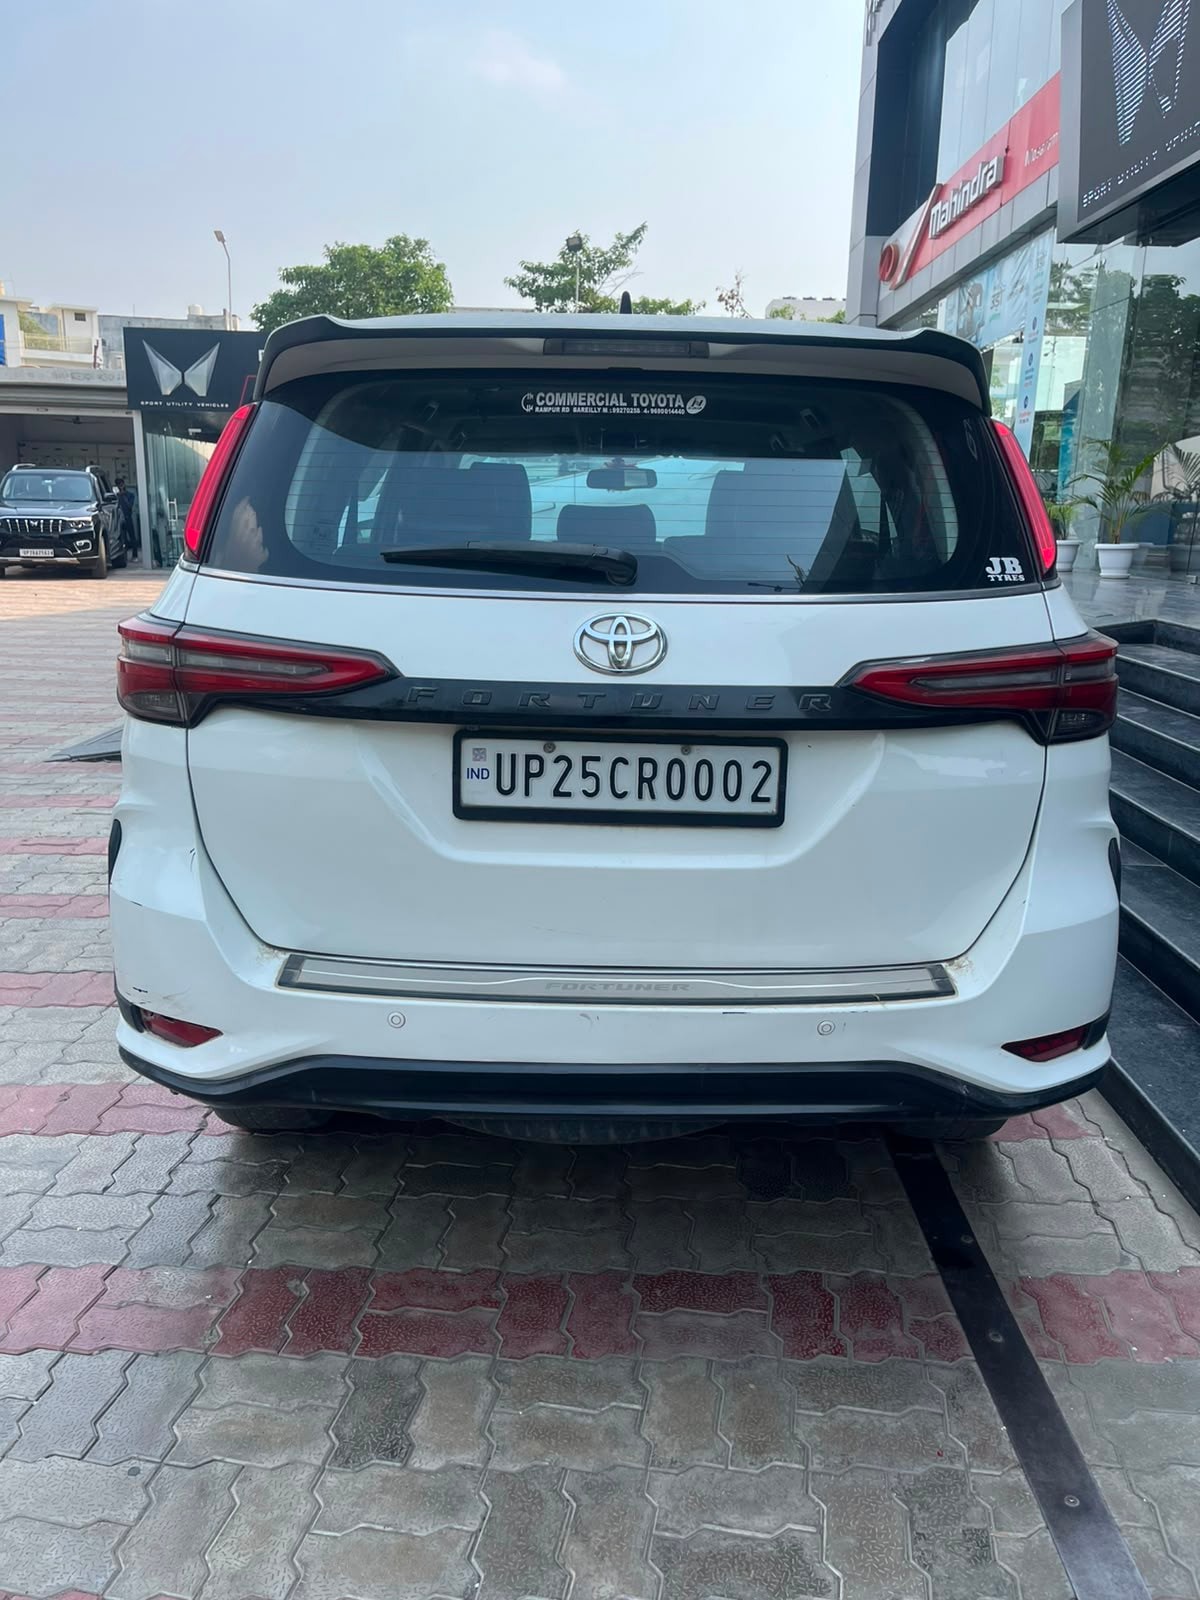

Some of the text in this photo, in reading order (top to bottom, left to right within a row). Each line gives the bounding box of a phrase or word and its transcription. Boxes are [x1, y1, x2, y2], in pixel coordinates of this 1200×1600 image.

[535, 391, 685, 408] COMMERCIAL TOYOTA
[985, 556, 1023, 575] JB
[987, 574, 1026, 582] TYRES
[407, 685, 833, 712] FORTUNER
[466, 752, 773, 803] IND UP25CR0002
[543, 982, 692, 992] FORTUNER
